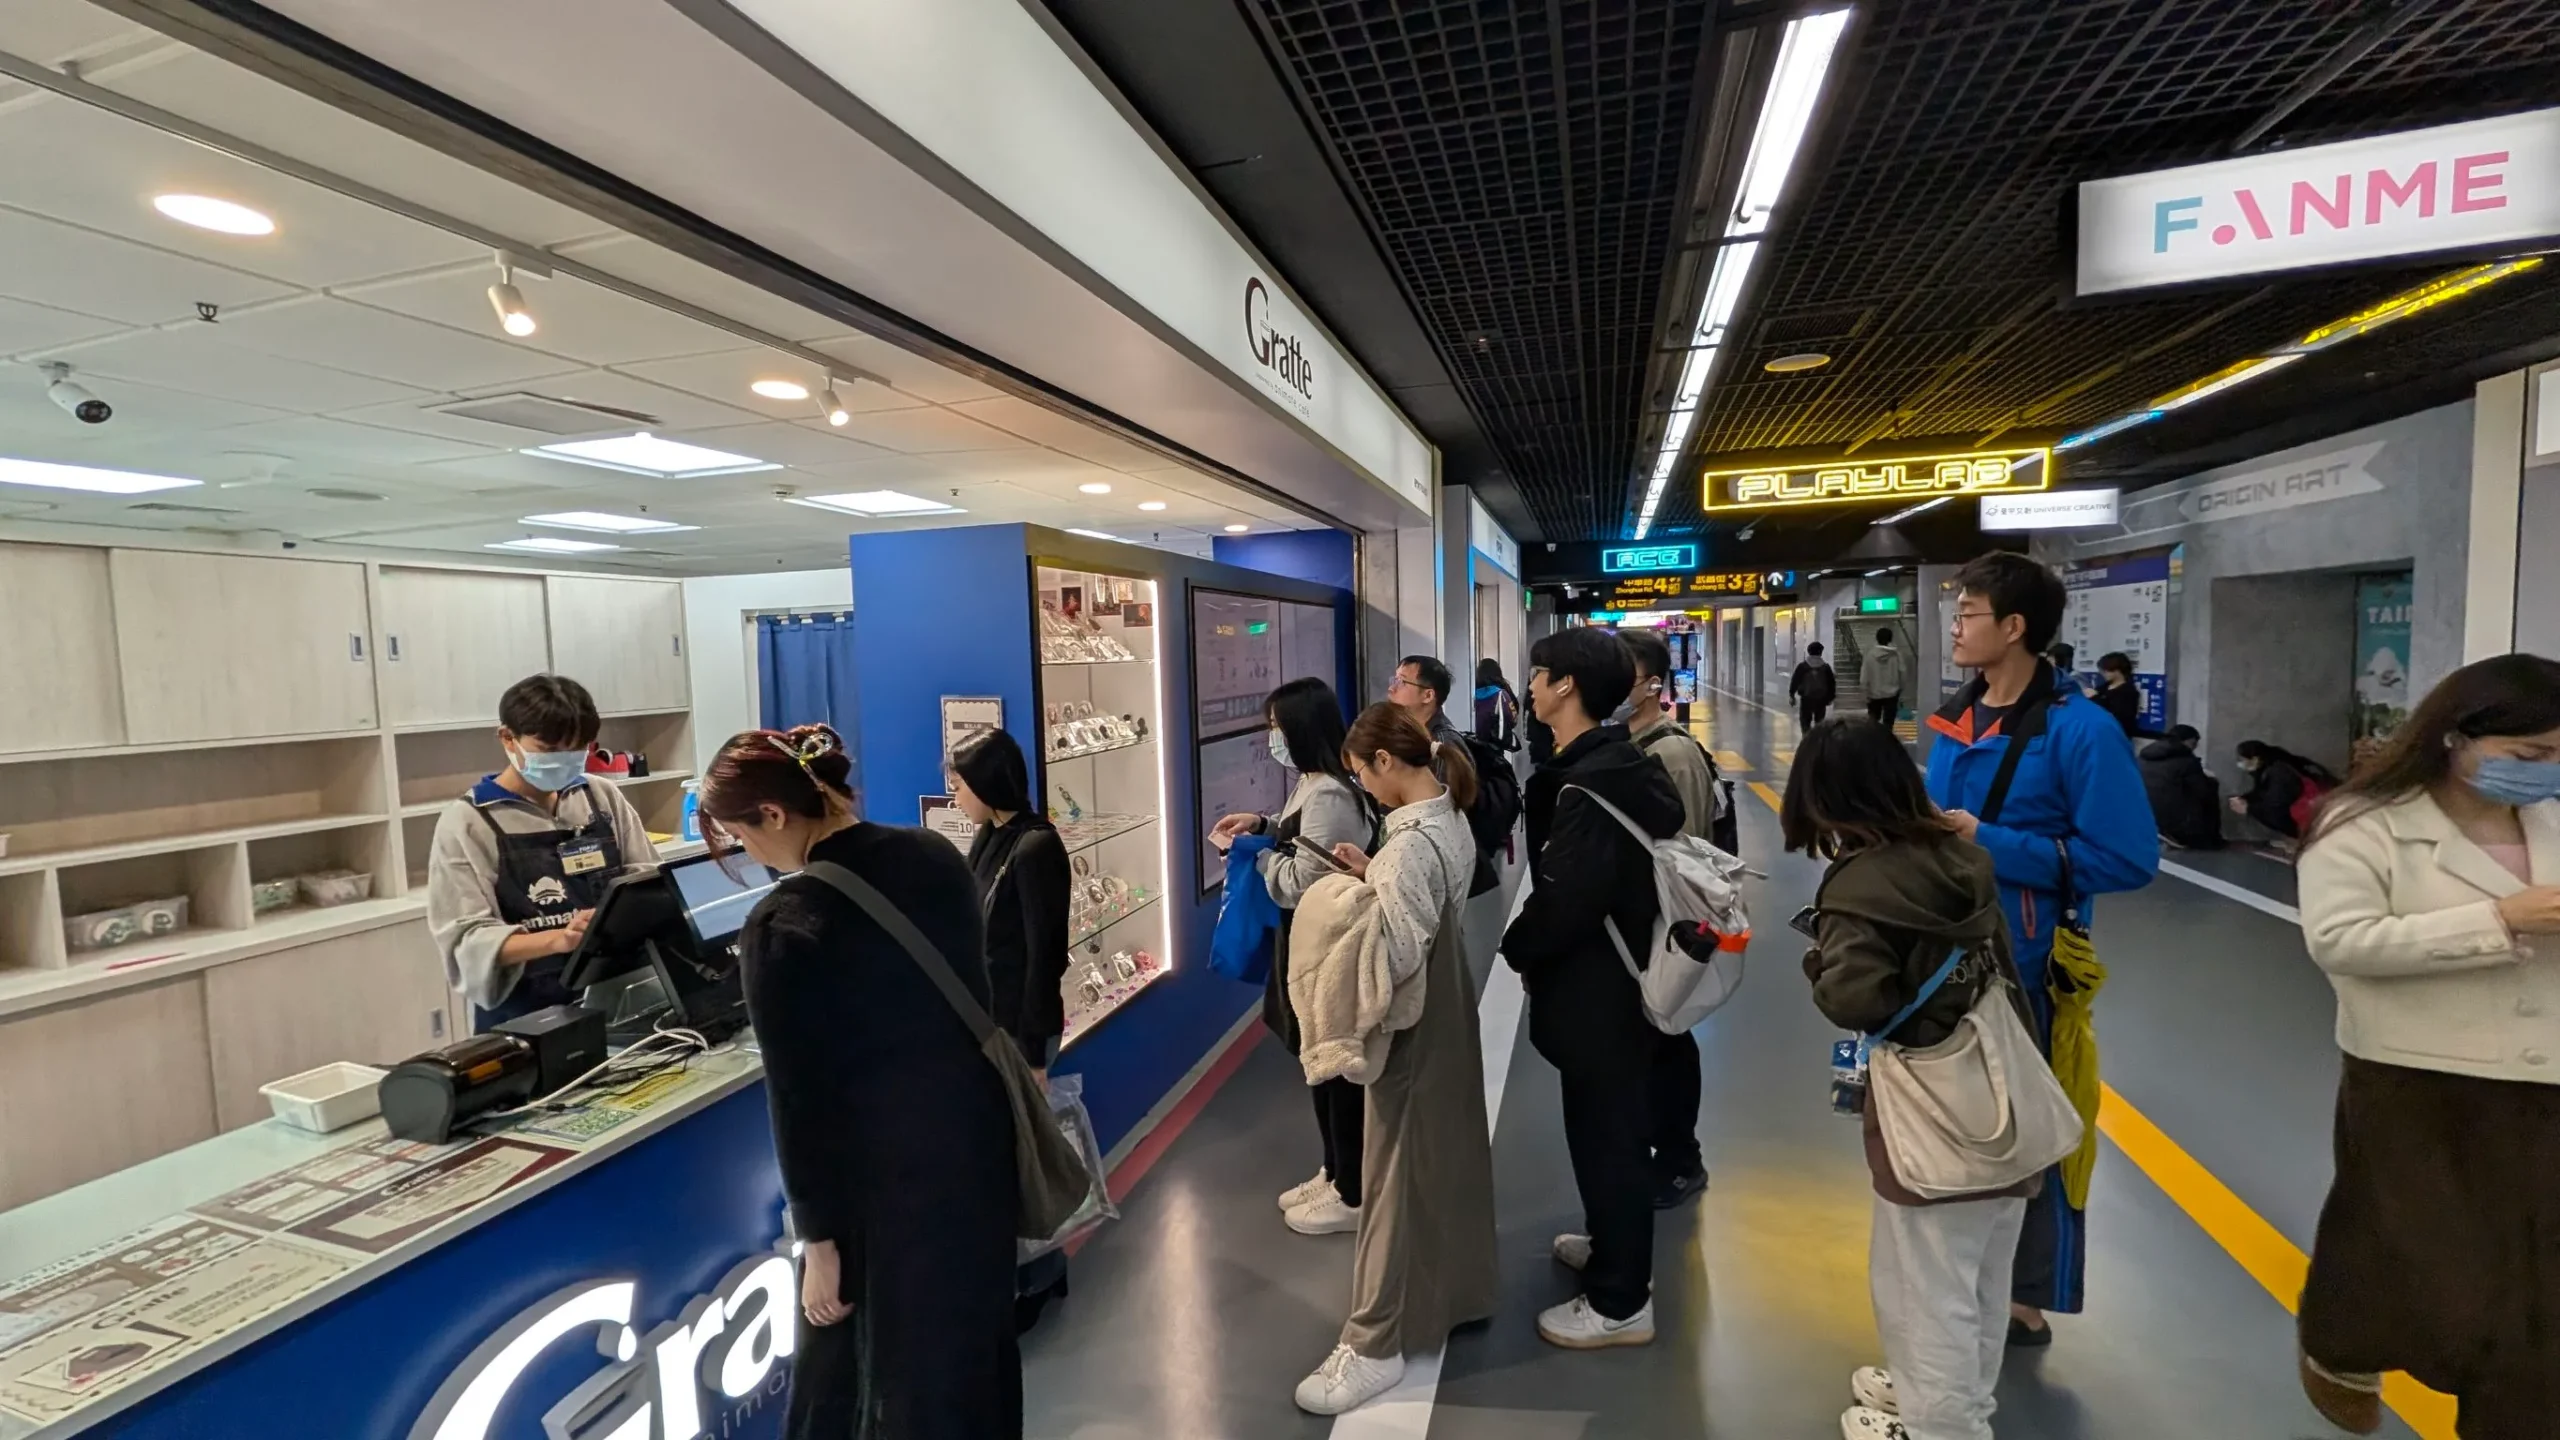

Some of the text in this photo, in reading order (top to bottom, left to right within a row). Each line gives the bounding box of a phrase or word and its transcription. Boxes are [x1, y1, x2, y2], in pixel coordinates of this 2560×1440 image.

[2153, 151, 2510, 254] FANME
[1244, 276, 1312, 400] Gratte
[1736, 457, 2012, 502] PLAYLAB
[2197, 462, 2350, 512] ORIGIN ART
[2034, 505, 2072, 513] UNIVERSE
[2073, 503, 2112, 511] CREATIVE
[1616, 549, 1681, 568] ACG
[1653, 577, 1668, 593] 4
[1728, 574, 1742, 590] 3
[959, 823, 972, 834] 10
[520, 908, 581, 929] anima
[91, 1286, 190, 1330] Gratte
[431, 1240, 804, 1440] Gra
